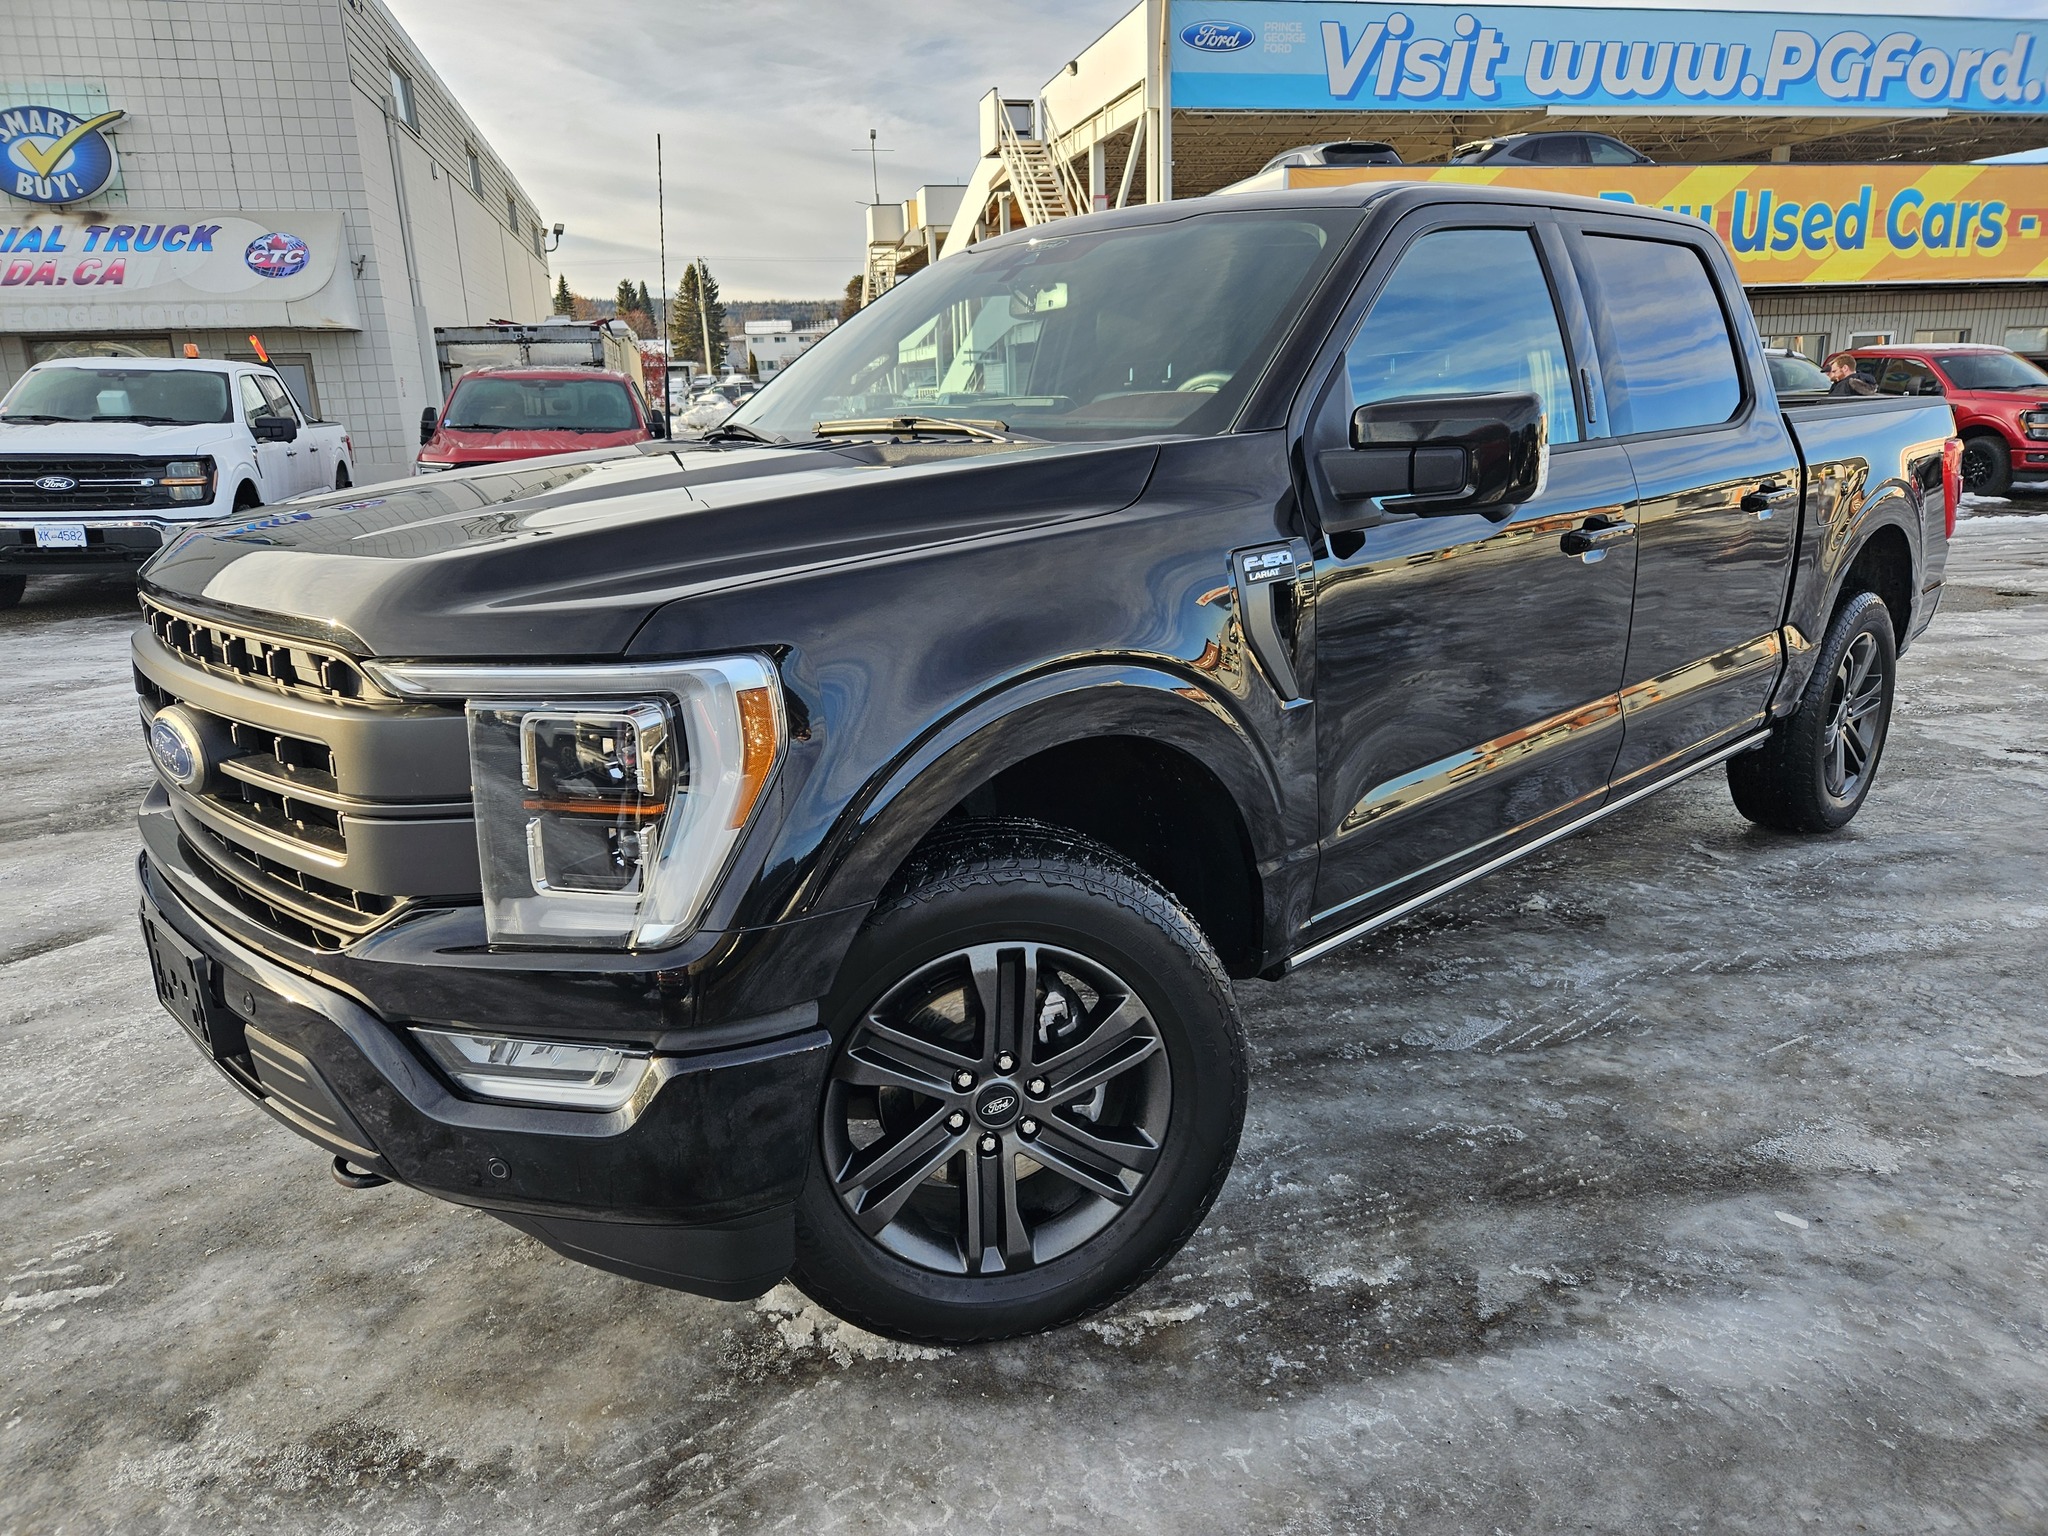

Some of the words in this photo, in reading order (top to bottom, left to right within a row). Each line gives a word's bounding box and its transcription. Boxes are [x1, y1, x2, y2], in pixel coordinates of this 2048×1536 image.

[1194, 24, 1240, 48] Ford
[1263, 22, 1303, 32] PRINCE
[1263, 33, 1306, 43] GEORGE
[1263, 43, 1292, 53] FORD
[1320, 12, 1503, 98] Visit
[1525, 29, 2048, 102] www.PGFord.
[0, 109, 82, 143] SMART
[16, 172, 83, 199] BUY!
[1731, 184, 1874, 253] Used
[1886, 188, 2006, 251] Cars
[0, 225, 66, 253] IAL
[83, 224, 222, 252] TRUCK
[248, 249, 305, 264] CTC
[0, 258, 126, 286] DA.CA
[1244, 551, 1292, 571] F-150
[1249, 568, 1280, 581] LARIAT
